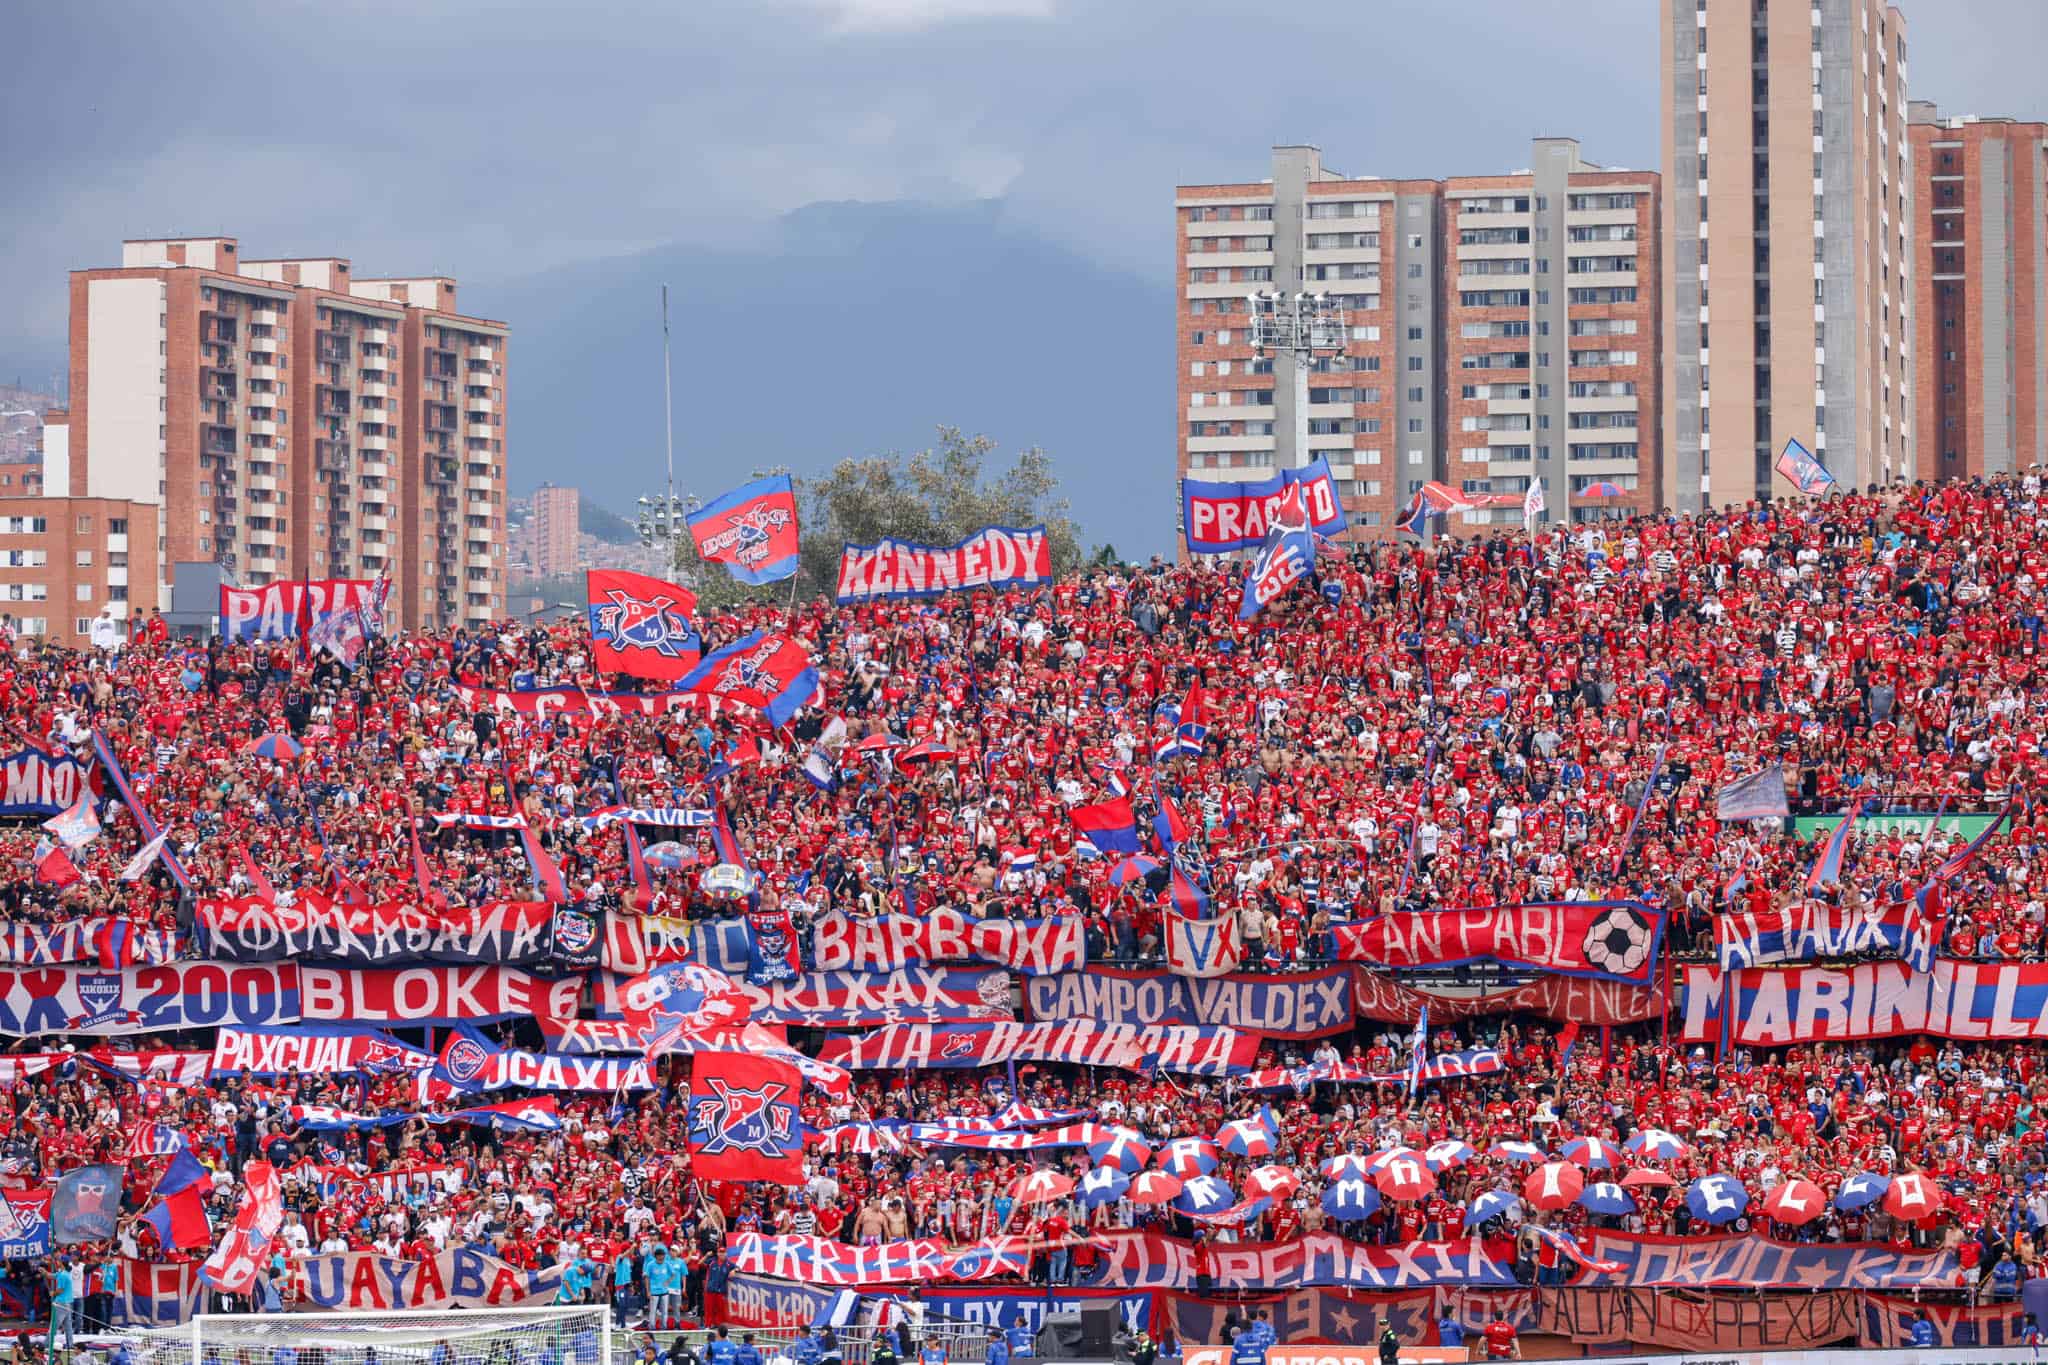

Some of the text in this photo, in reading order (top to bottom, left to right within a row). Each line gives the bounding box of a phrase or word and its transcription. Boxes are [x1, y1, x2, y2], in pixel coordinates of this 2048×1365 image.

[838, 528, 1045, 599] KENNEDY
[813, 907, 1085, 975] BARBOXA
[1341, 911, 1443, 965] XAN
[136, 963, 300, 1026] 2001
[302, 966, 533, 1020] BLOKE
[1029, 973, 1346, 1033] CAMPO VALDEX
[213, 1027, 355, 1073] PAXCUAL
[254, 1247, 562, 1311] UAYABAL
[735, 1231, 1022, 1285] ARRIERX
